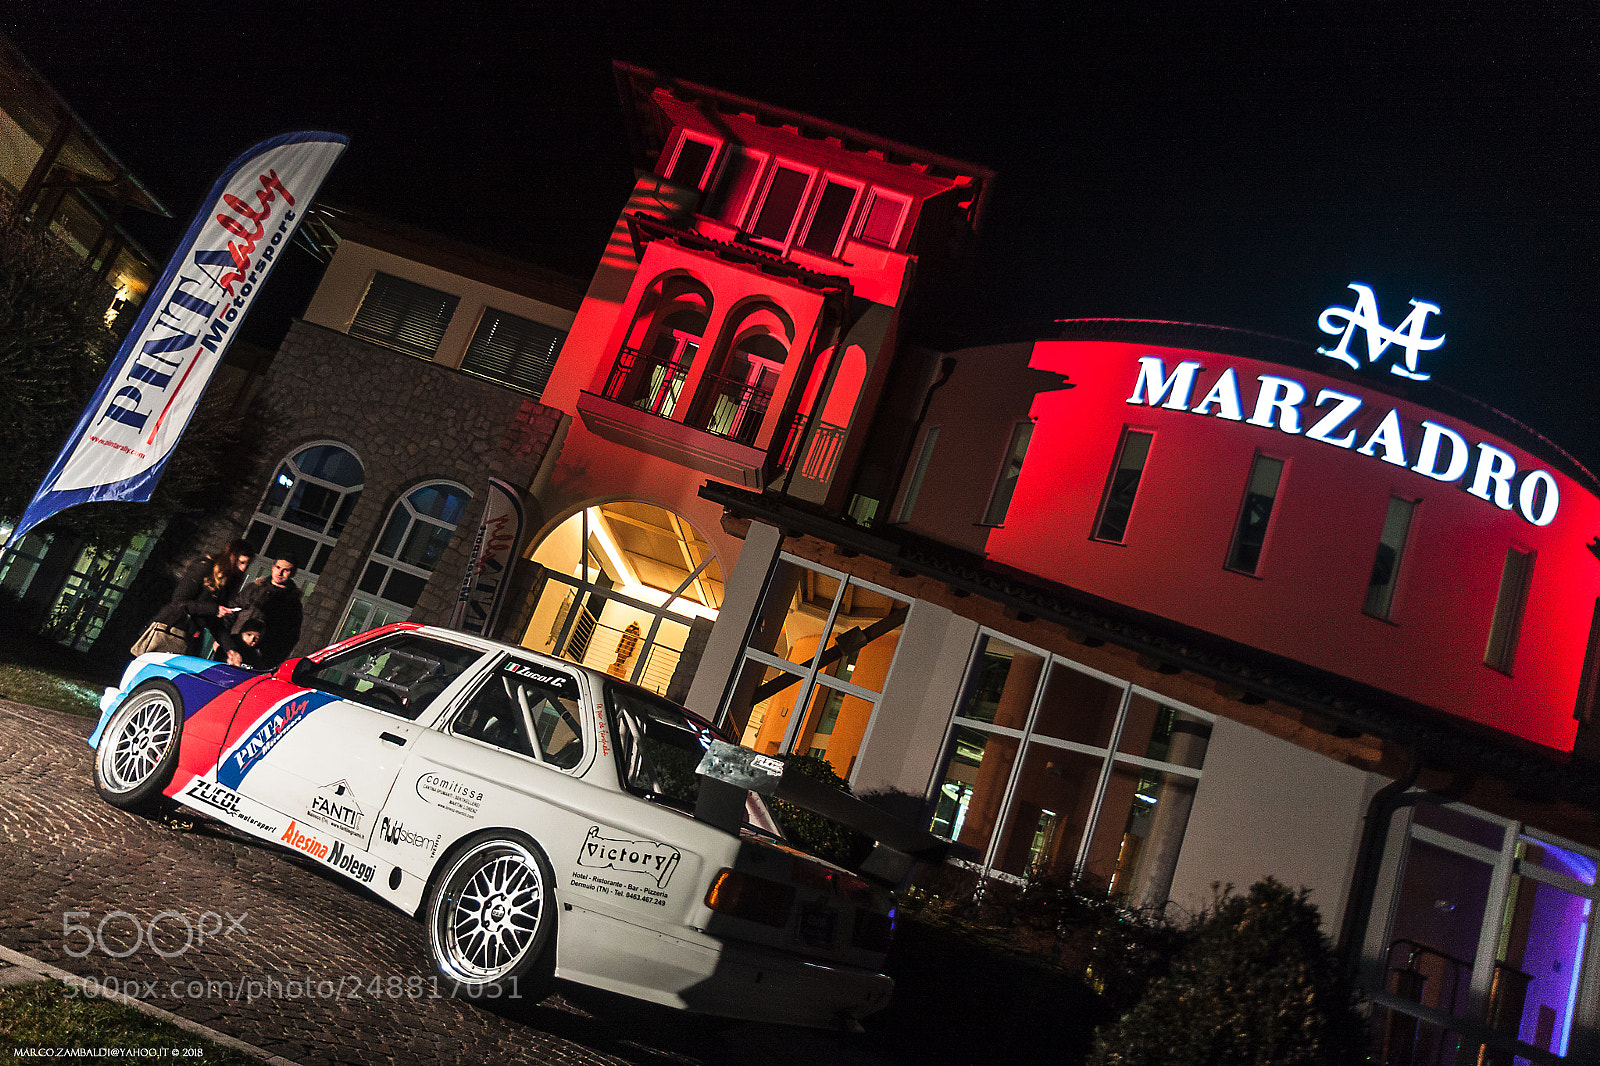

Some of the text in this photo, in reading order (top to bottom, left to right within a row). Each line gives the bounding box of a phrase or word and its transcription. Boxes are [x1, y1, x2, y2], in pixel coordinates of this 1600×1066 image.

[216, 169, 296, 297] rally
[201, 209, 296, 354] Motorsport
[97, 249, 240, 434] PINTA
[1125, 355, 1560, 527] MARZADRO
[516, 665, 553, 684] Zucol
[233, 714, 284, 769] PINTA
[185, 779, 242, 817] ZUCOL
[426, 775, 484, 801] comitissa
[312, 795, 356, 825] FANTI
[280, 820, 329, 860] Atesina
[326, 840, 377, 883] Noleggi
[572, 871, 588, 881] Hotel
[592, 875, 623, 888] Ristorante
[627, 884, 639, 892] Bar
[643, 888, 668, 899] Pizzeria
